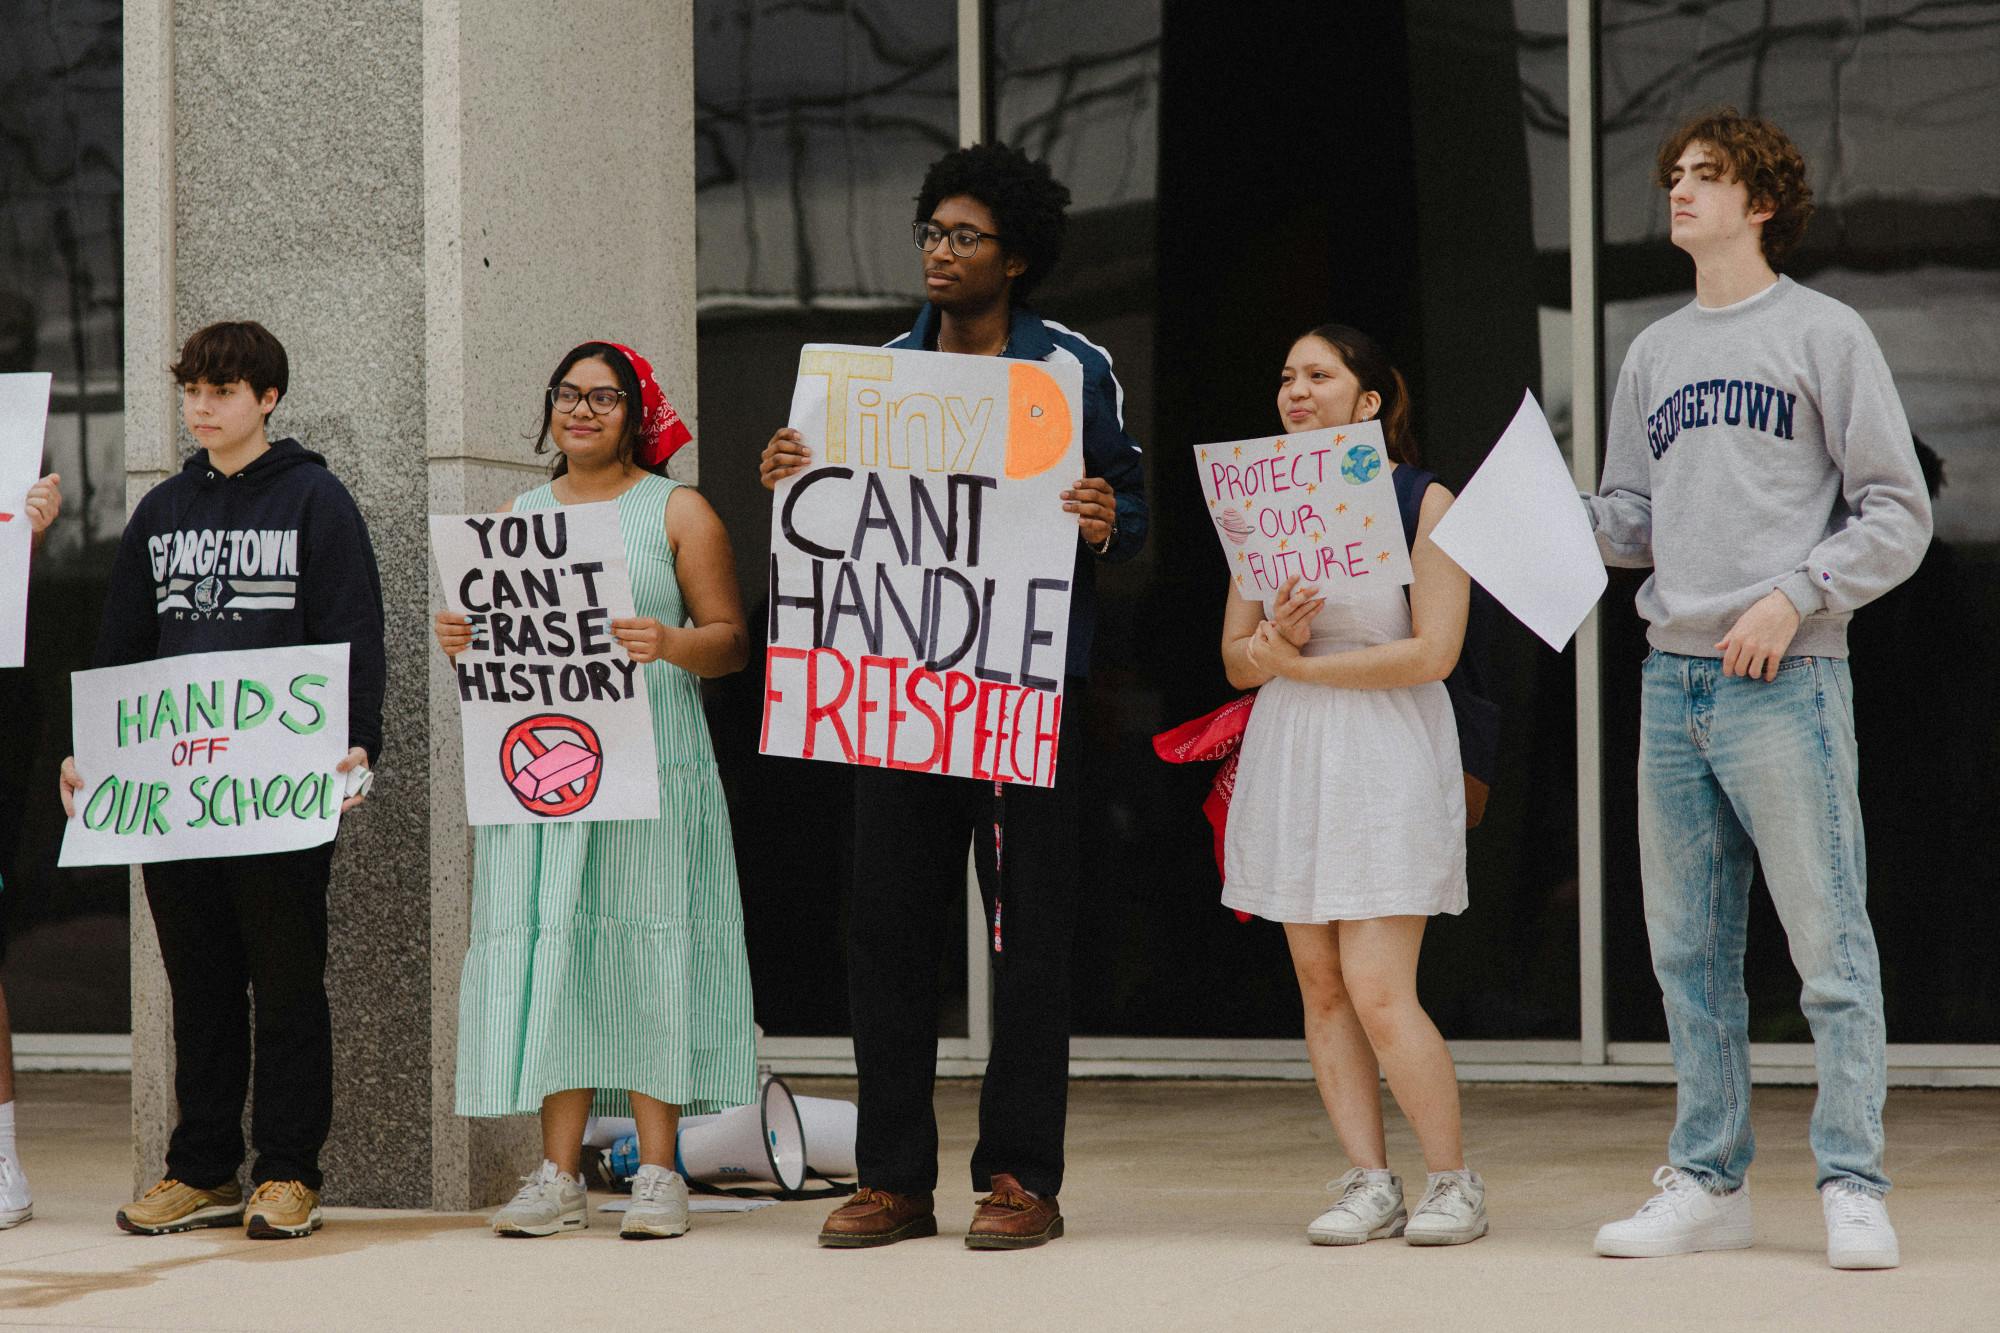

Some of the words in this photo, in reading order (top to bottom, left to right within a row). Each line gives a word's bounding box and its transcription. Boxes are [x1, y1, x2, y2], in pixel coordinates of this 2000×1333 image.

[799, 350, 994, 473] Tiny
[1003, 362, 1073, 480] D
[1648, 379, 1797, 460] GEORGETOWN
[1211, 449, 1331, 500] PROTECT
[465, 512, 567, 559] YOU
[781, 466, 997, 567] CANT
[1259, 504, 1327, 538] OUR
[148, 529, 299, 582] GEORGETOWN
[1248, 541, 1369, 591] FUTURE
[459, 561, 604, 613] CAN'T
[467, 607, 611, 657] ERASE
[770, 553, 1069, 692] HANDLE
[457, 658, 638, 706] HISTORY
[117, 674, 329, 748] HANDS
[172, 737, 230, 766] OFF
[82, 774, 172, 835] OUR
[186, 771, 337, 828] SCHOOL
